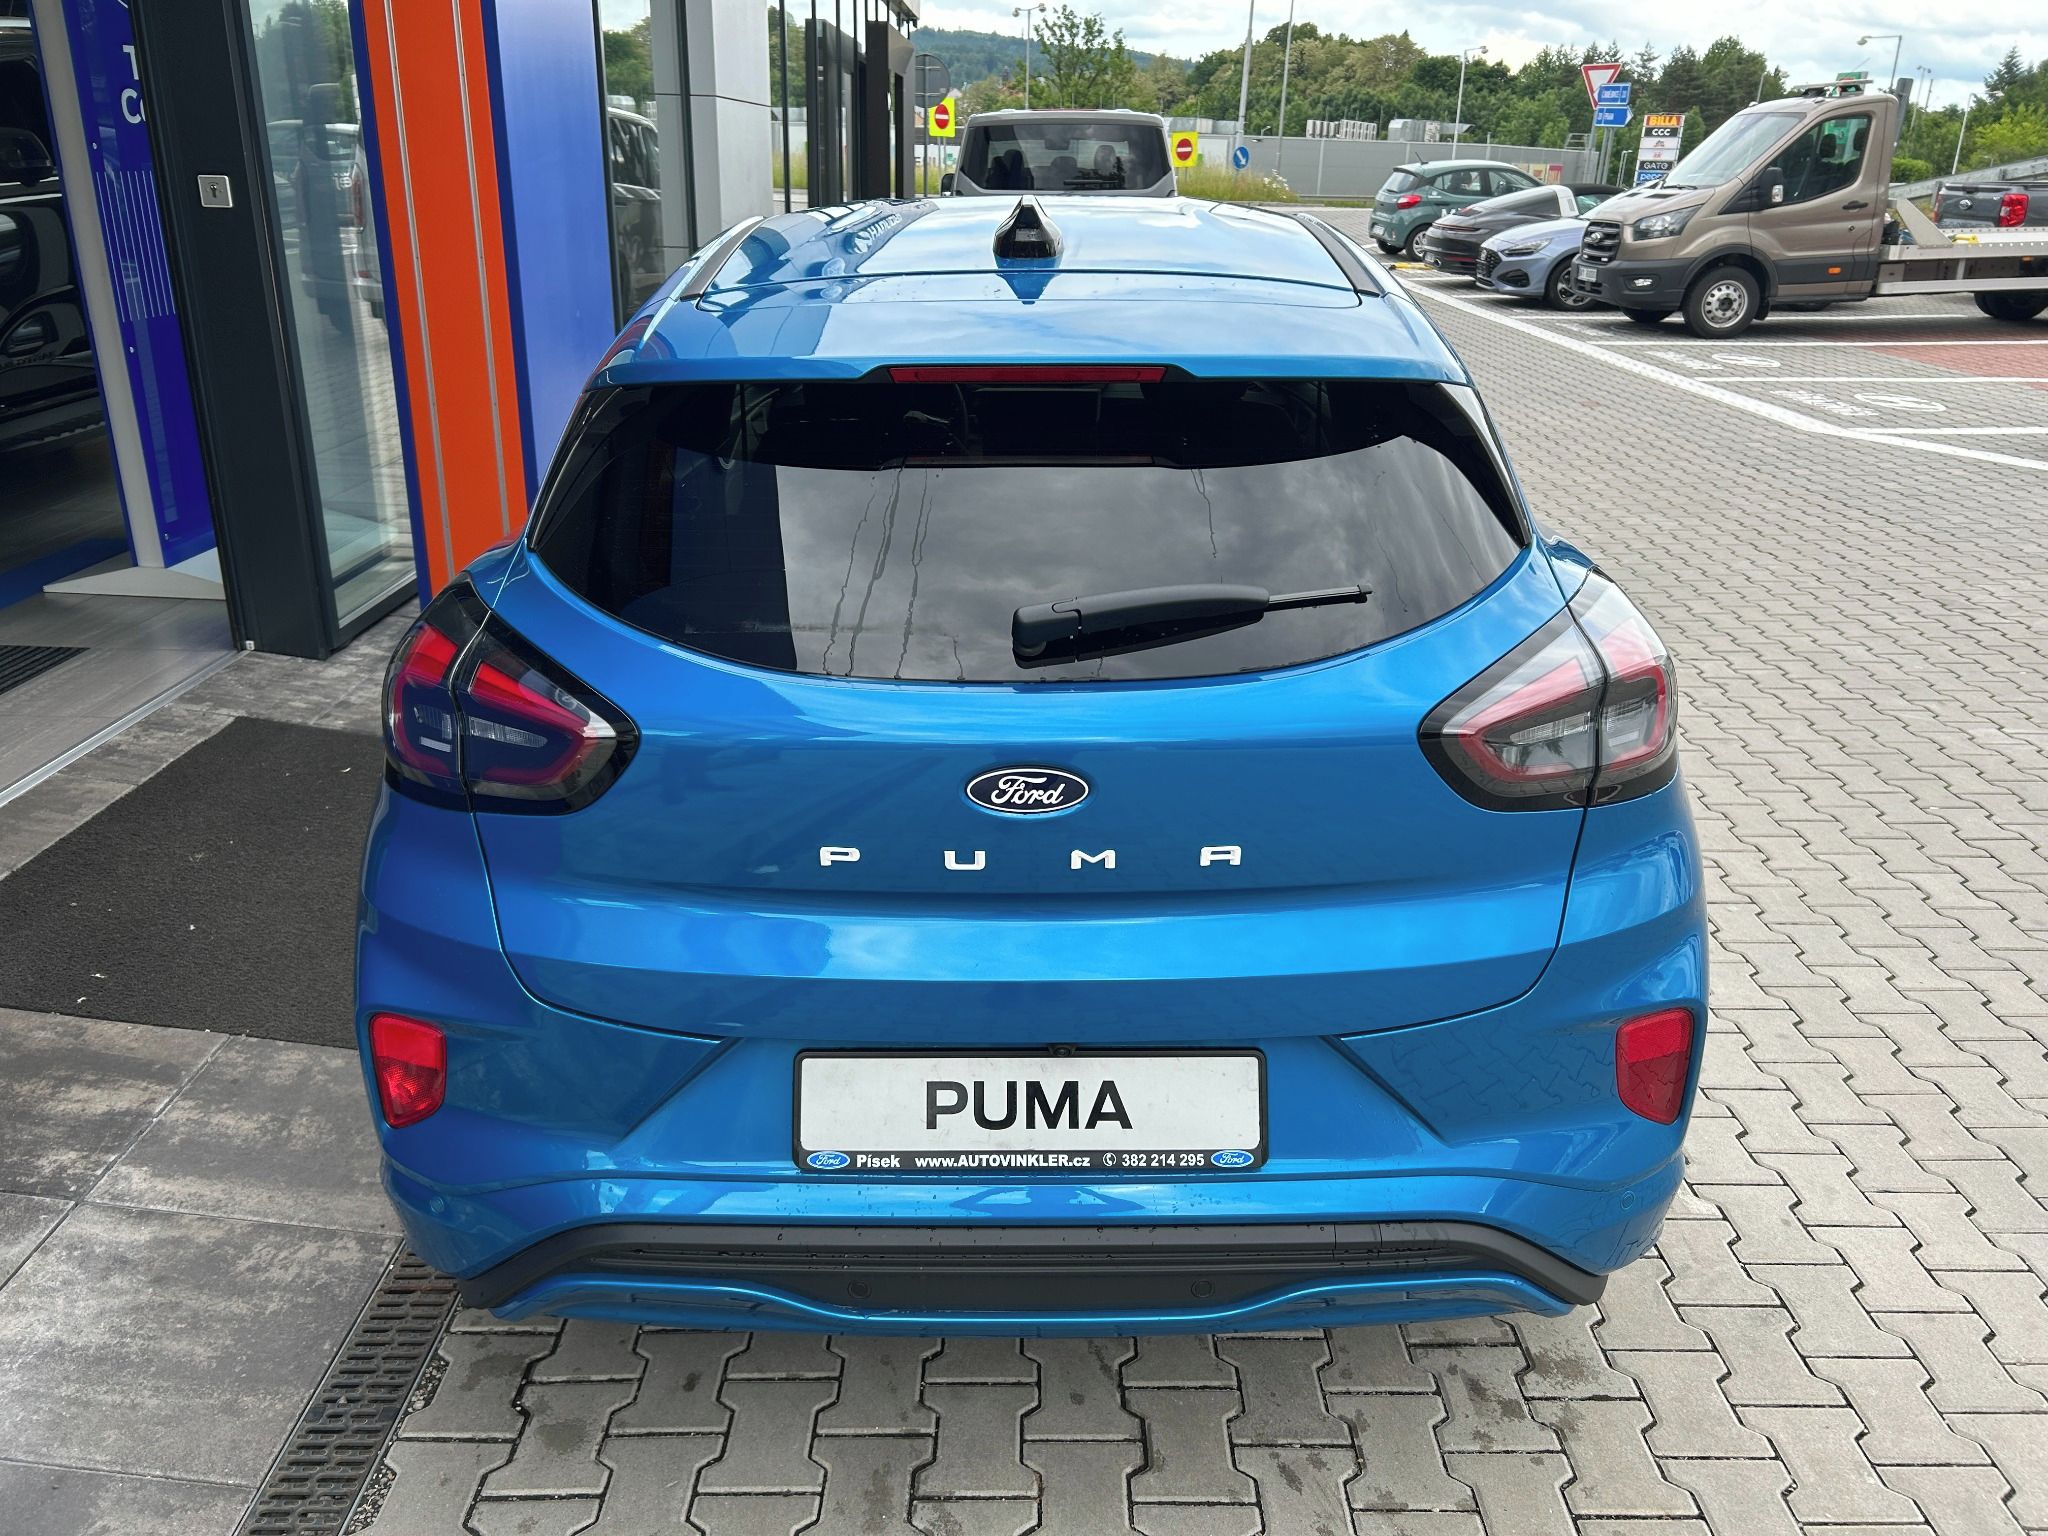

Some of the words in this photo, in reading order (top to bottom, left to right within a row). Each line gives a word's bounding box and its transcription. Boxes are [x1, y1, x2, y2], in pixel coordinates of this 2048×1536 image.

[1648, 116, 1678, 126] BILLA
[1652, 128, 1671, 136] CCC
[990, 775, 1063, 805] Ford
[819, 845, 1242, 871] PUMA
[925, 1080, 1133, 1131] PUMA
[856, 1154, 901, 1168] Písek
[914, 1153, 1091, 1168] www.AUTOVINKLER.cz
[1121, 1153, 1147, 1167] 382
[1150, 1153, 1176, 1167] 214
[1179, 1153, 1205, 1167] 295
